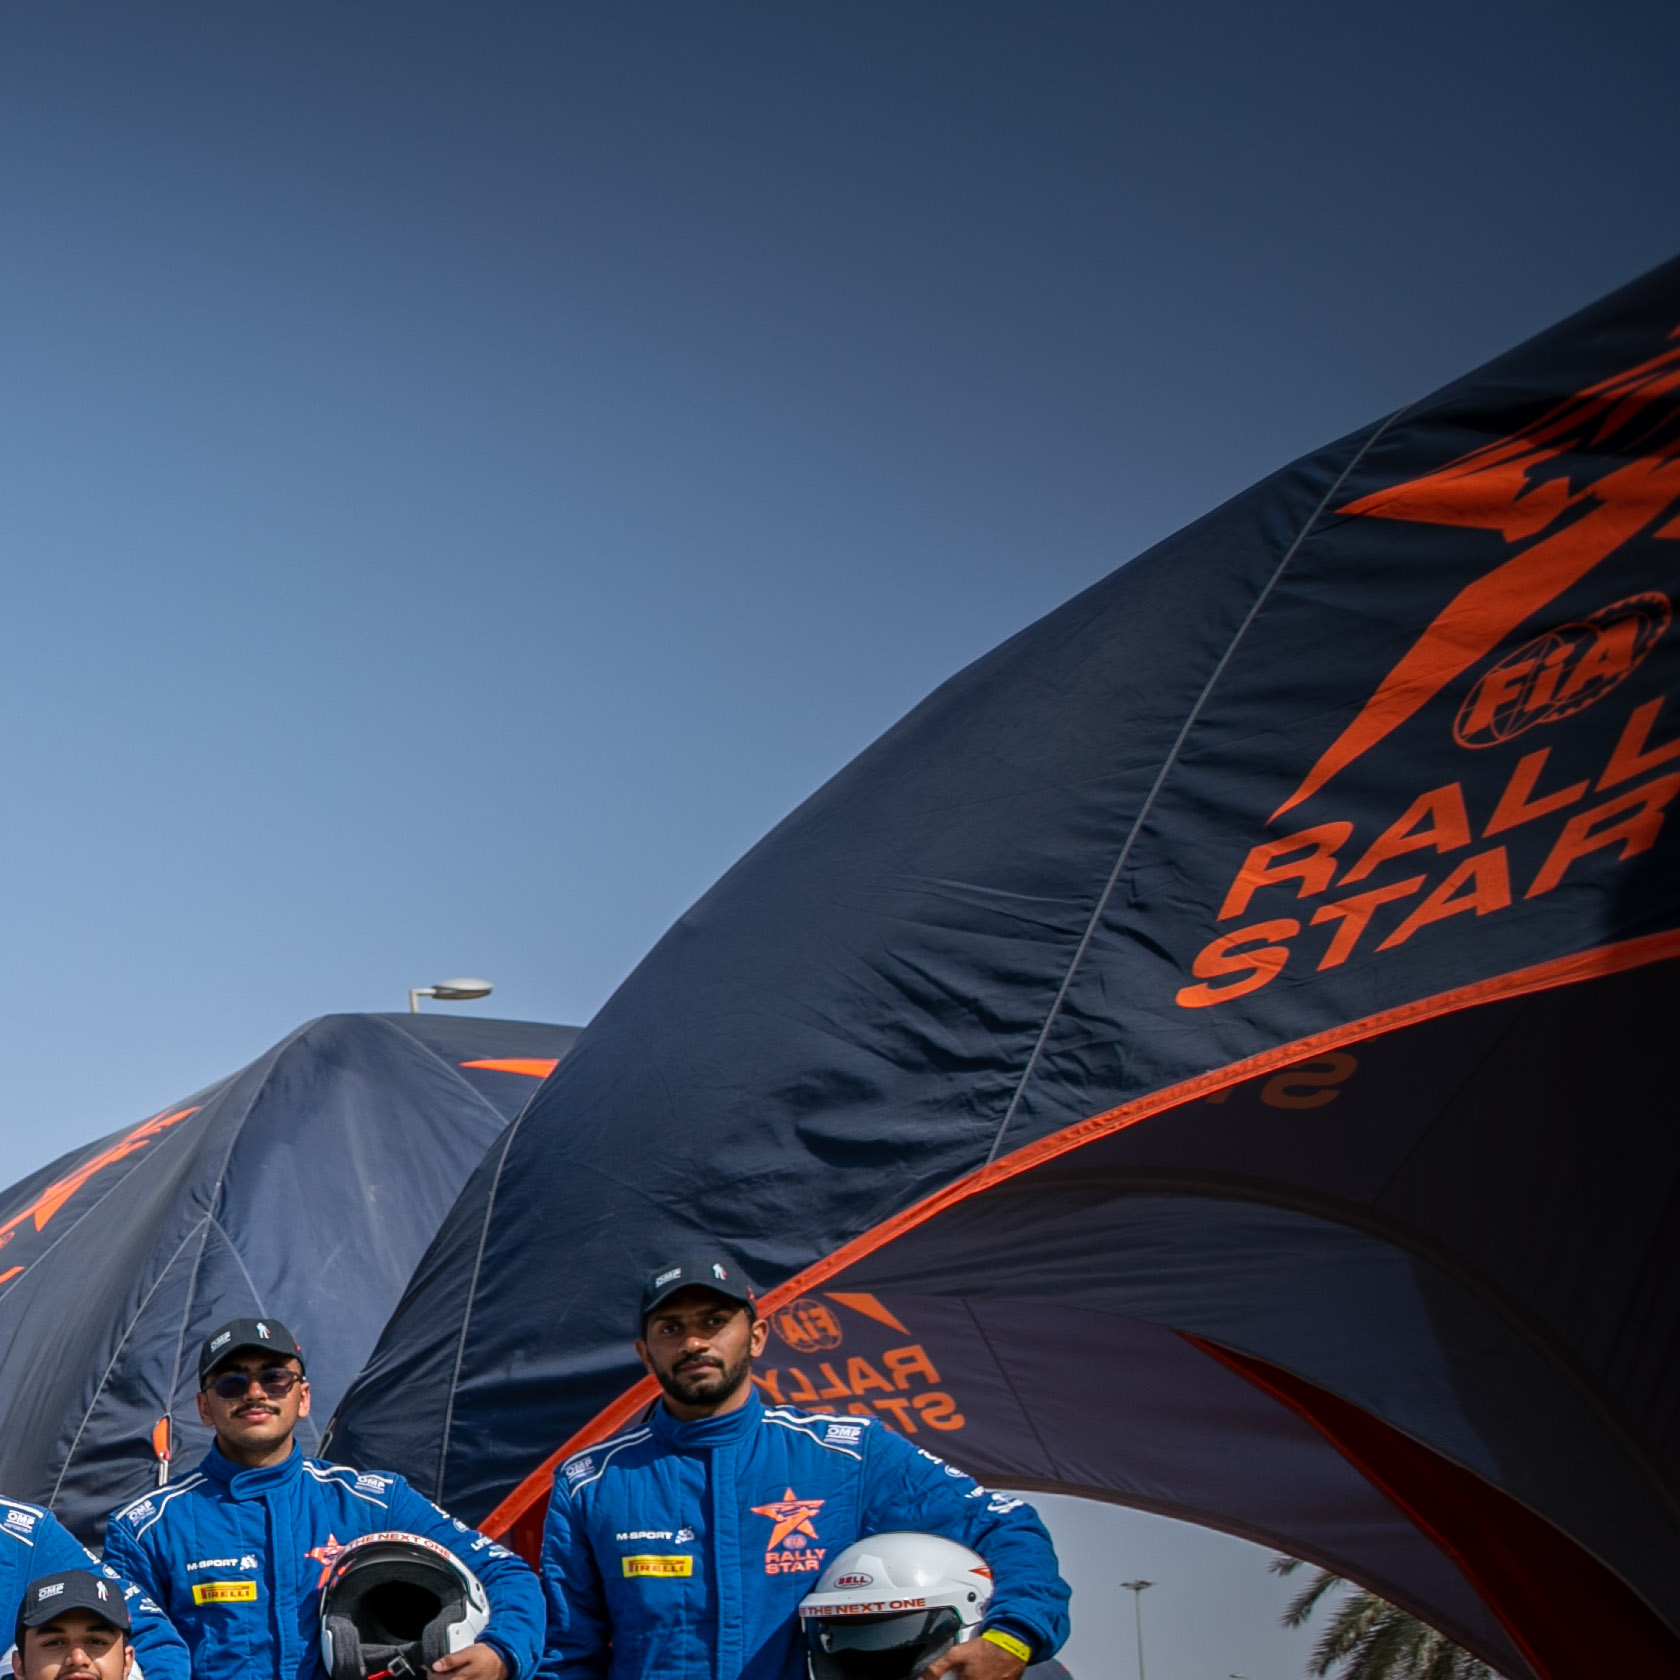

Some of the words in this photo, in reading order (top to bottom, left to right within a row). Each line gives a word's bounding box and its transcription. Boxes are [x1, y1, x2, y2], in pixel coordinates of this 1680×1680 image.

[1175, 772, 1680, 1009] STAR
[827, 1426, 860, 1438] OMP
[566, 1459, 593, 1476] OMP
[358, 1476, 385, 1488] OMP
[127, 1500, 153, 1520] OMP
[7, 1511, 36, 1527] OMP
[616, 1532, 672, 1541] M-SPORT
[377, 1533, 422, 1544] NEXT
[424, 1540, 451, 1558] ONE
[765, 1549, 827, 1564] RALLY
[187, 1559, 238, 1571] M-SPORT
[628, 1560, 685, 1573] PIRELLI
[765, 1560, 820, 1575] STAR
[838, 1575, 867, 1586] BELL
[38, 1585, 64, 1598] OMP
[200, 1586, 250, 1600] PIRELLI
[808, 1605, 832, 1616] THE
[836, 1602, 884, 1615] NEXT
[889, 1598, 926, 1610] ONE
